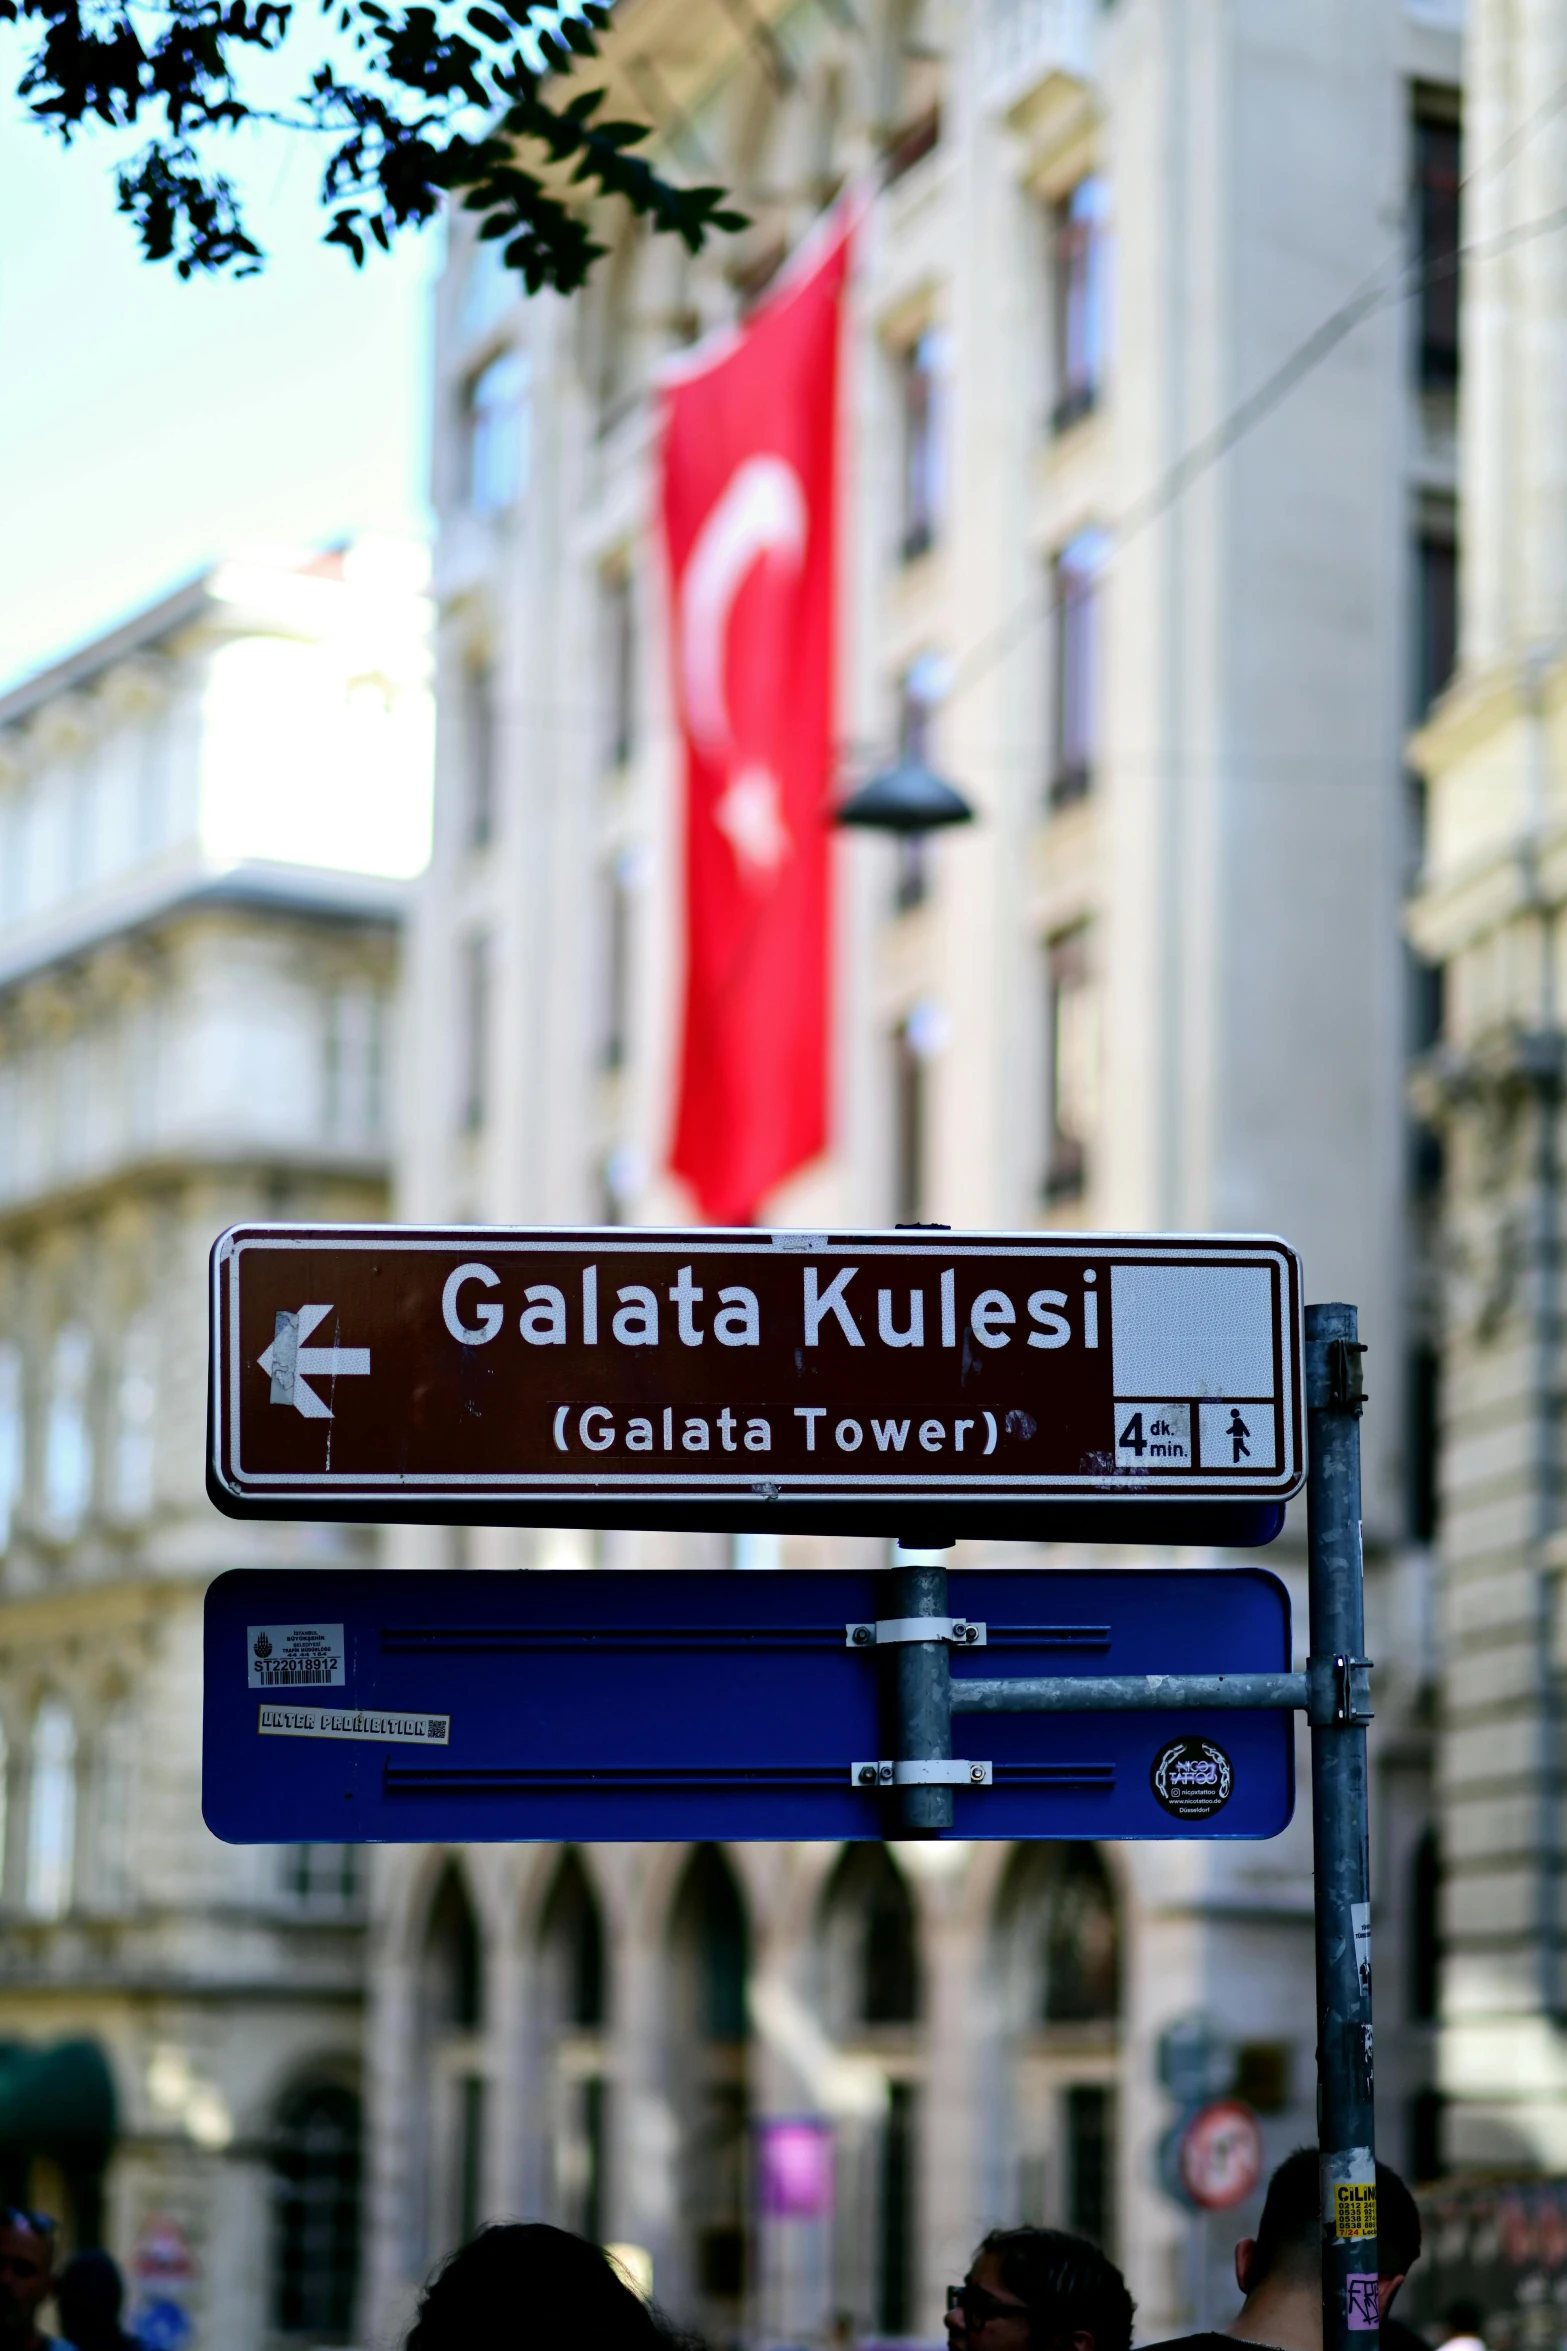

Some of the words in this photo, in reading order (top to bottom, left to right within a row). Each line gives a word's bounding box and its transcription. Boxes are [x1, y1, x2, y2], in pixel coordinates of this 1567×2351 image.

[441, 1262, 761, 1347] Galata
[803, 1266, 1100, 1349] Kulesi
[552, 1405, 772, 1453] (Galata
[794, 1407, 998, 1455] Tower)
[1119, 1412, 1147, 1457] 4
[1150, 1420, 1175, 1436] dk.
[1150, 1441, 1188, 1457] min.
[254, 1658, 338, 1672] ST22018912
[262, 1711, 316, 1730] UNTER
[320, 1714, 427, 1736] PROHIBITION
